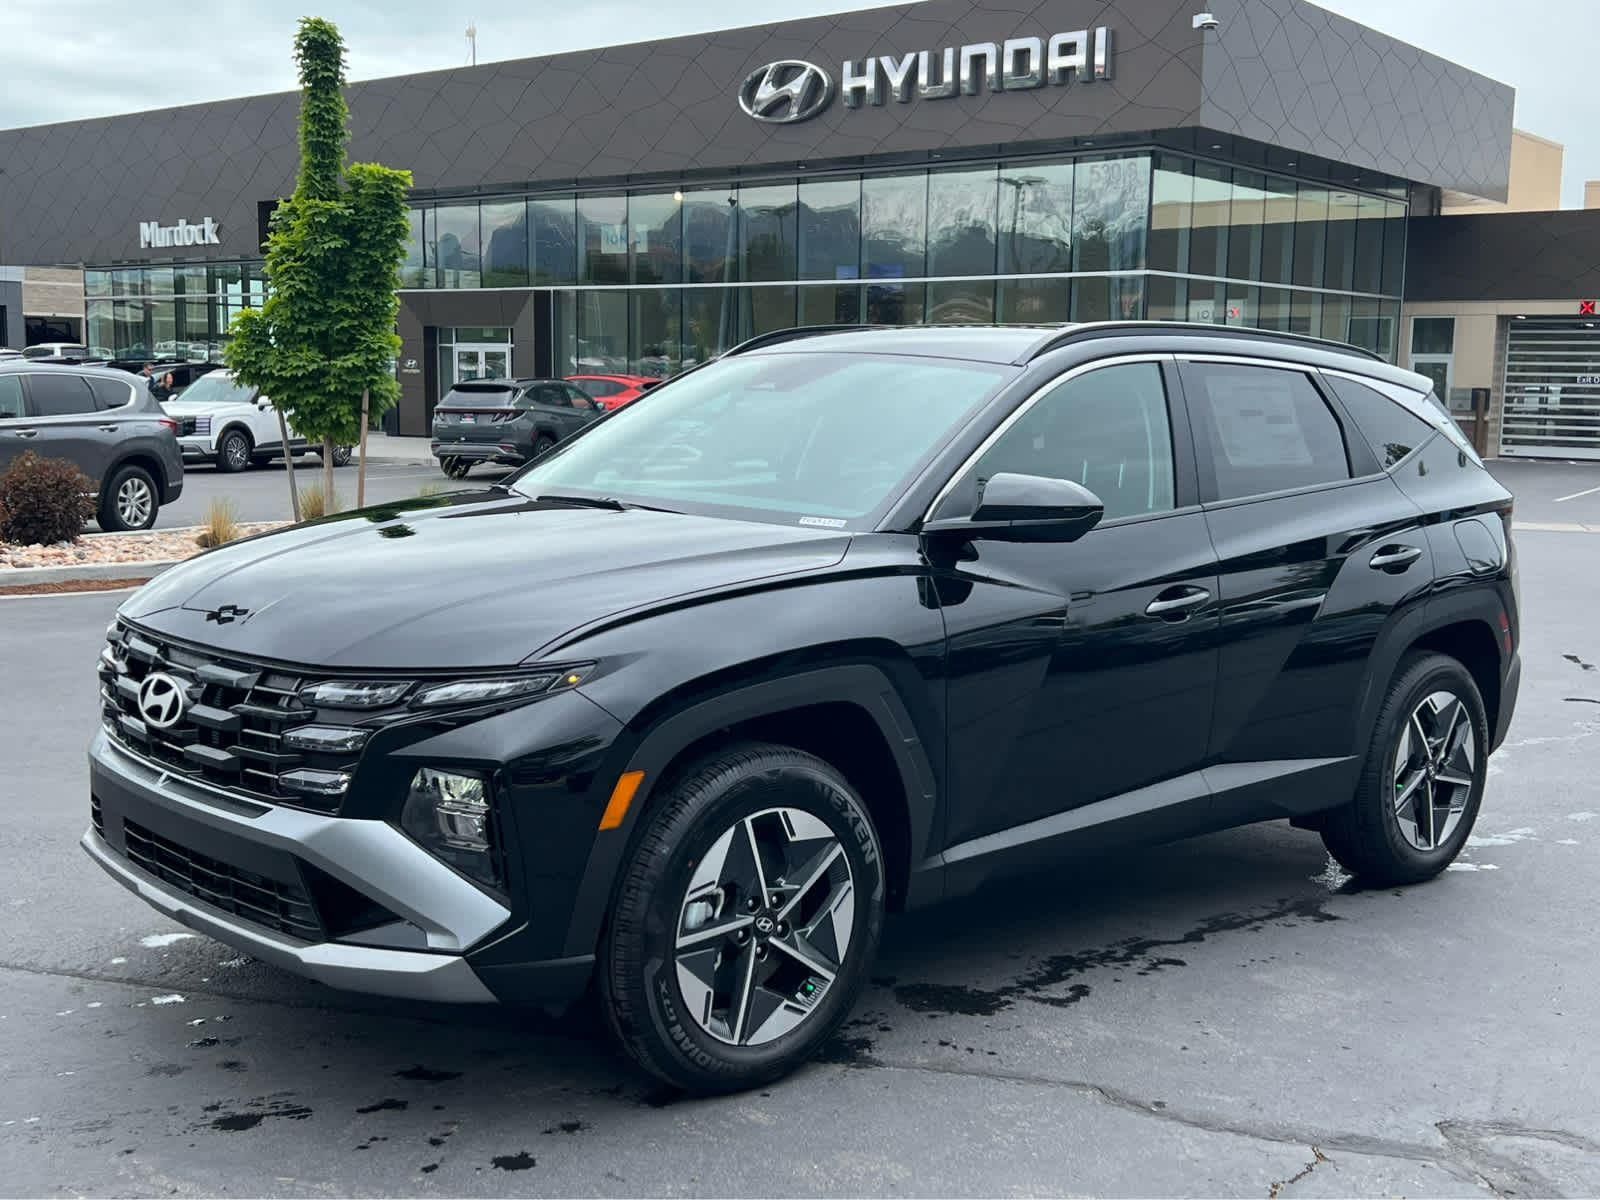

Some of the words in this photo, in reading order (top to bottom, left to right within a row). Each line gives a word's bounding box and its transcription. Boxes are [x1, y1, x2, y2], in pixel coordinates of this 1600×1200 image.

[842, 26, 1112, 108] HYUNDAI
[139, 216, 221, 248] Murdock
[1576, 375, 1592, 385] Exit
[814, 781, 877, 864] NEXEN
